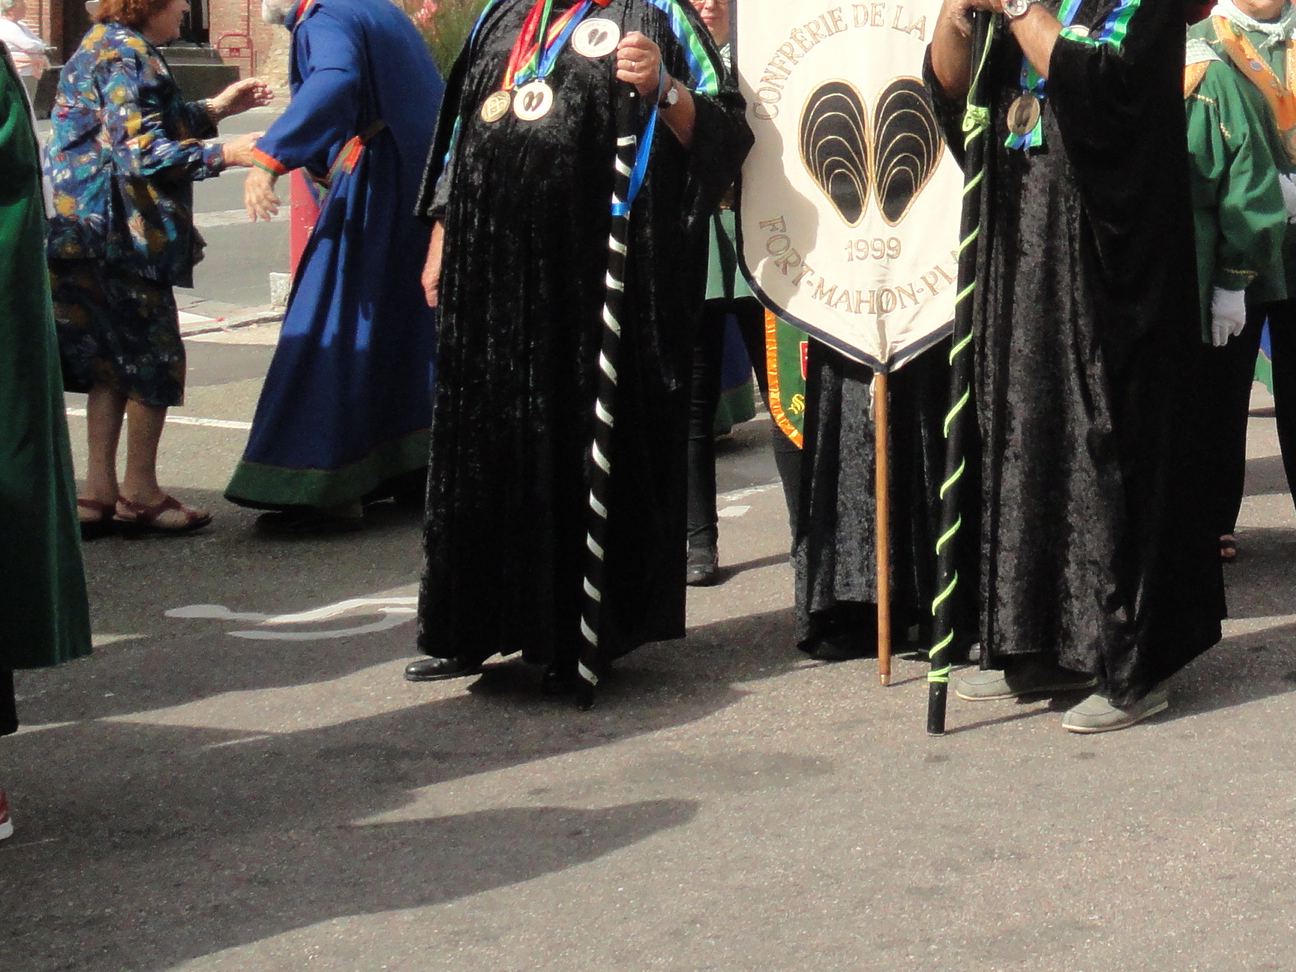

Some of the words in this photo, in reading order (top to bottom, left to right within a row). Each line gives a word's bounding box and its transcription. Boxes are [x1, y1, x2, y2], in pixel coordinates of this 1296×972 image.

[852, 2, 886, 28] DE
[891, 4, 927, 42] LA
[844, 236, 902, 262] 1999
